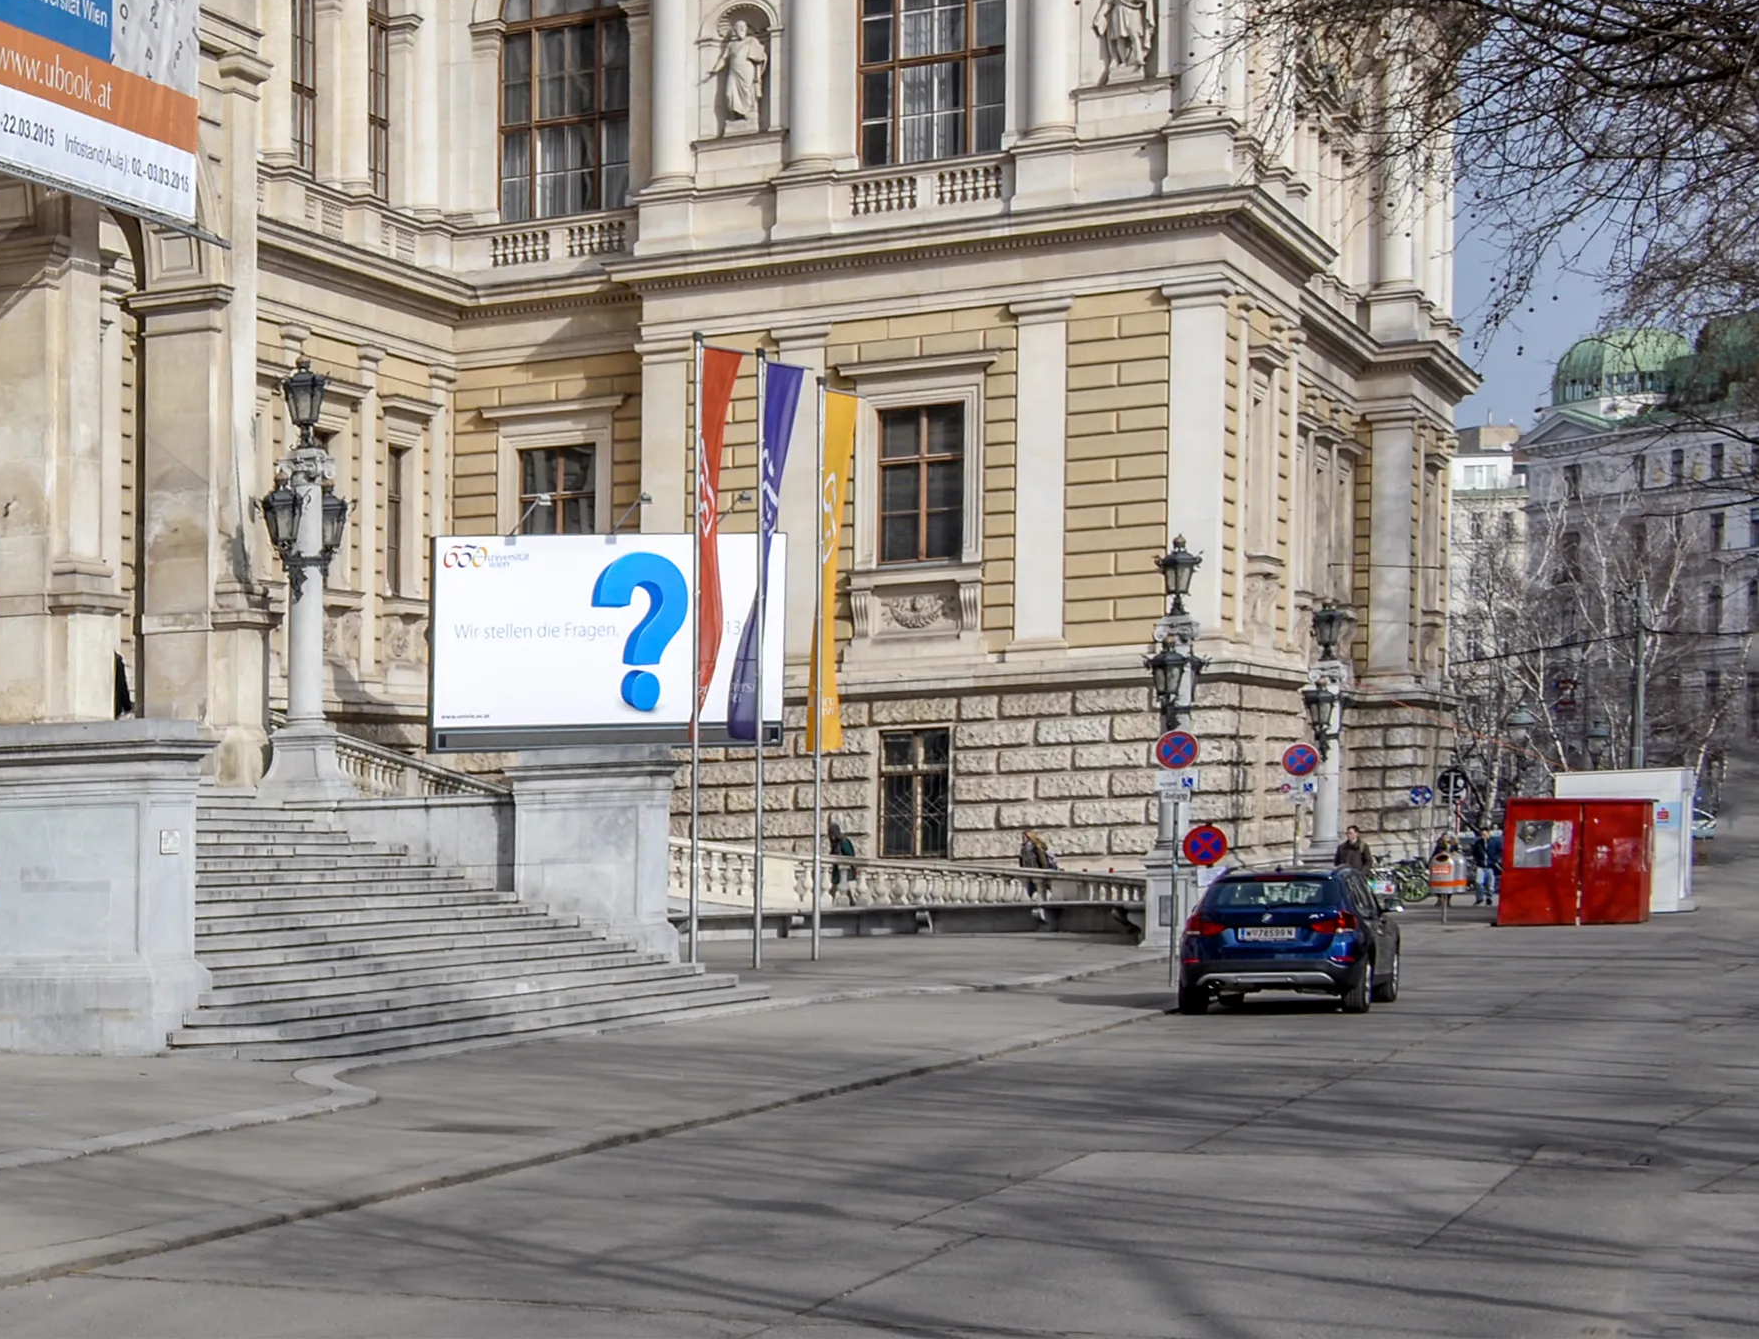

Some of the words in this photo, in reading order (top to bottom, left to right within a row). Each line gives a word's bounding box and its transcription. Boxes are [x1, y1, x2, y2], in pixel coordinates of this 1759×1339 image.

[454, 624, 479, 639] Wir
[483, 623, 532, 639] stellen
[536, 622, 560, 638] die
[564, 621, 619, 641] Fragen.
